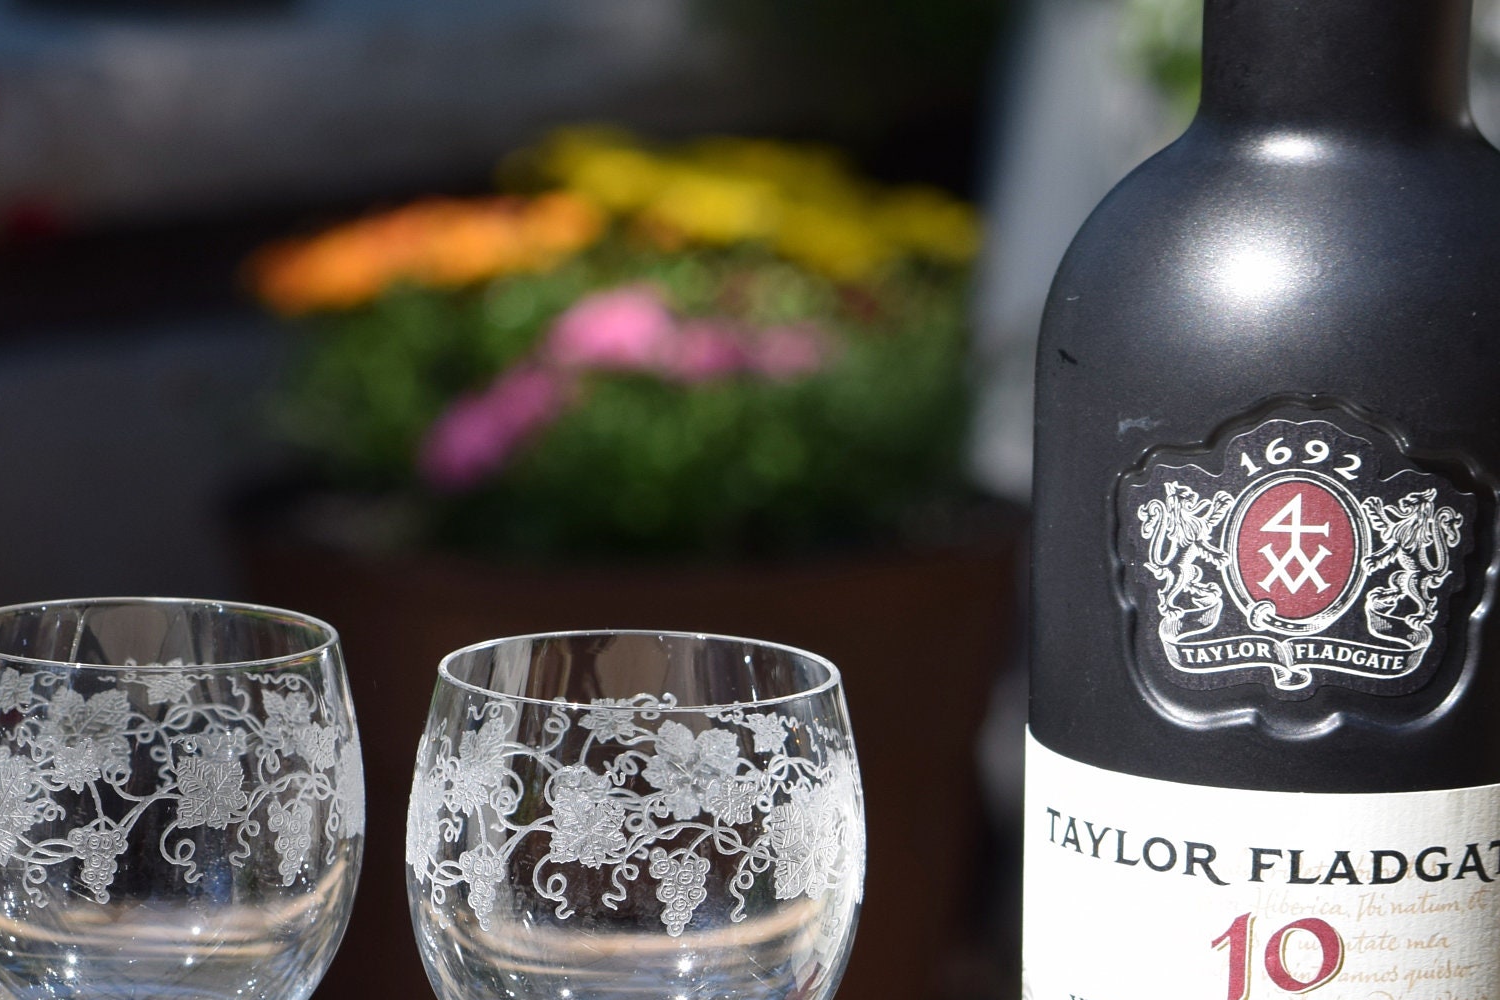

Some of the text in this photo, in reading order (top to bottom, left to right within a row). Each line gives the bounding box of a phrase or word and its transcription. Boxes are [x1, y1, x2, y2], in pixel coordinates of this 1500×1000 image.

[1239, 437, 1363, 480] 1692
[1182, 641, 1404, 671] TAYLOR FLADGATE
[1046, 806, 1231, 886] TAYLOR
